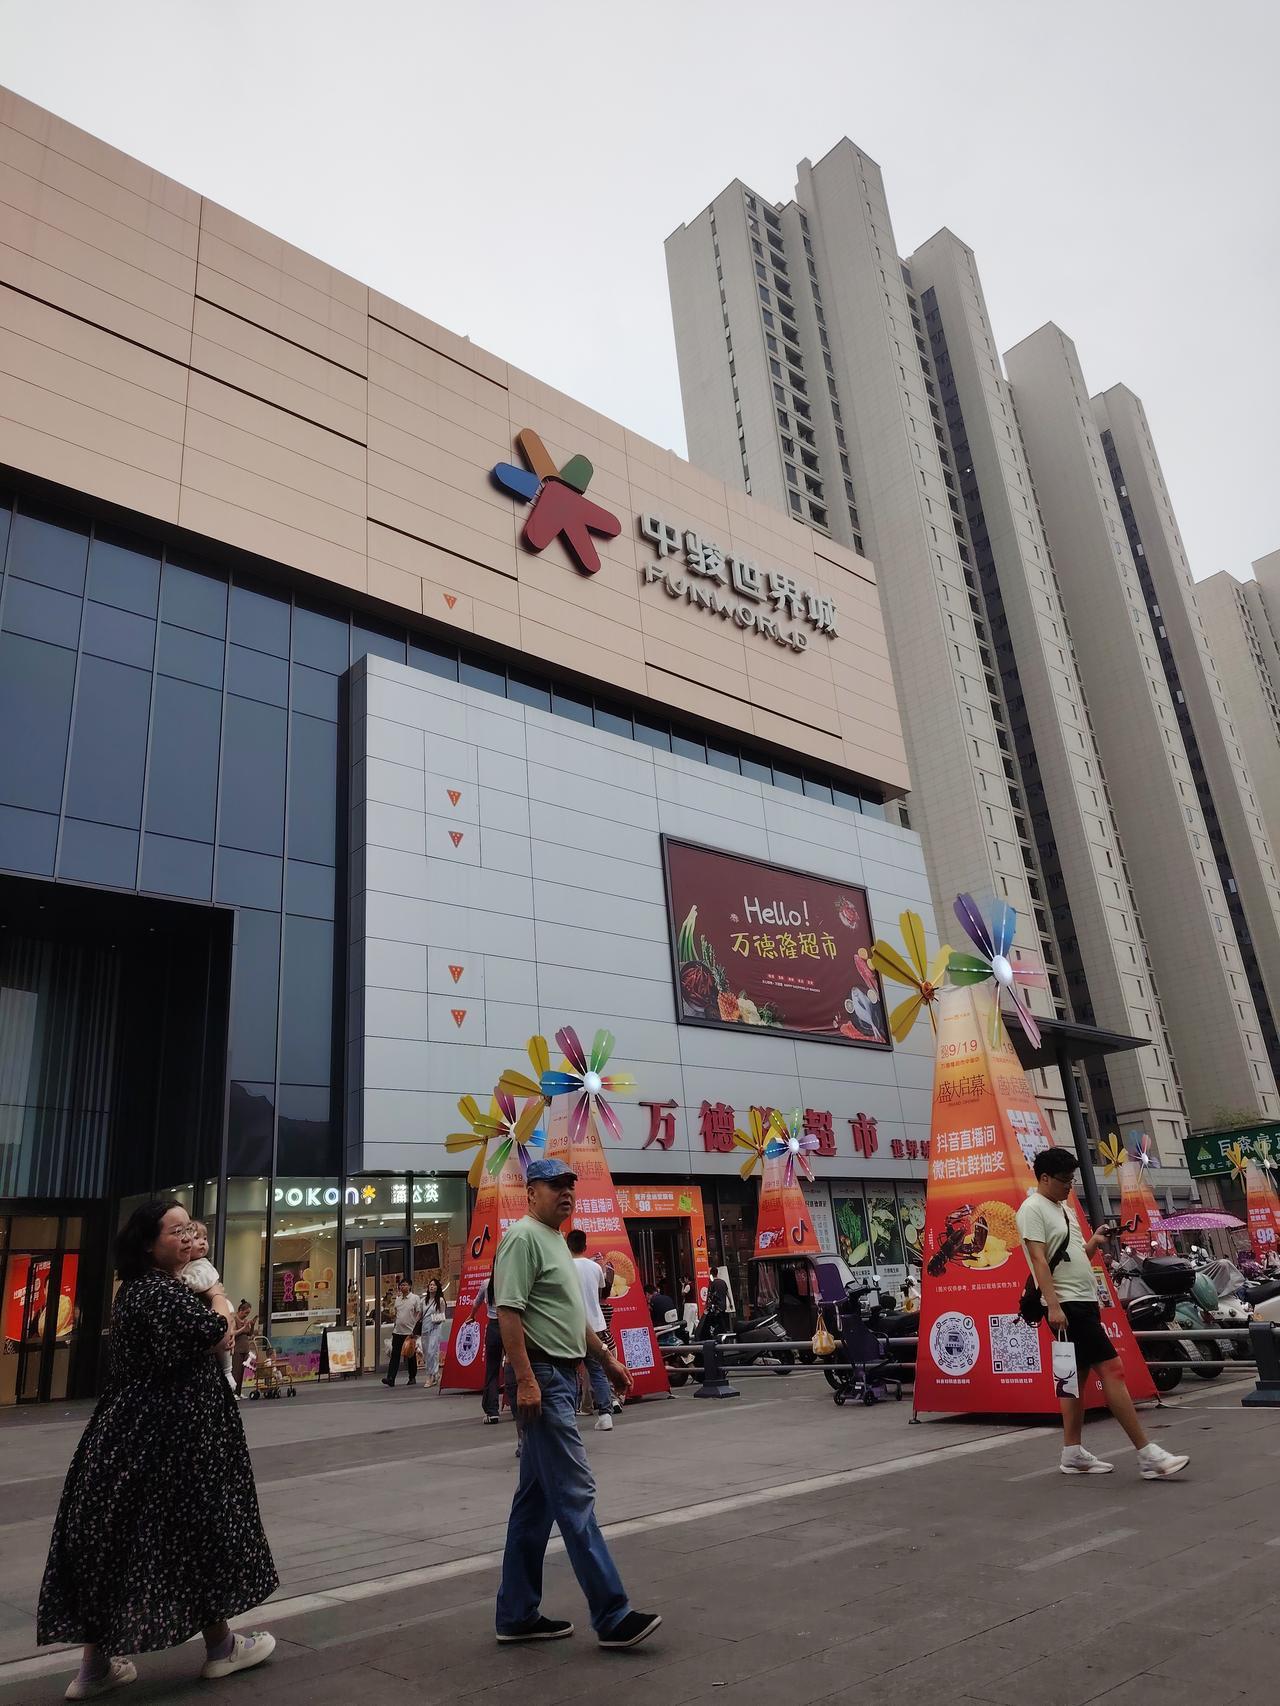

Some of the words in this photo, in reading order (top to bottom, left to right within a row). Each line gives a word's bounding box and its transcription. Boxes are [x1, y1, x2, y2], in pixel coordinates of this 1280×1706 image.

[640, 512, 839, 640] 中骏世界城
[644, 561, 808, 653] FUNWORLD
[743, 895, 810, 927] Hello!
[730, 931, 838, 960] 万德隆超市
[936, 1125, 996, 1153] 抖音直播间
[932, 1151, 1005, 1180] 微信社群抽奖
[575, 1198, 614, 1213] 抖音直播间
